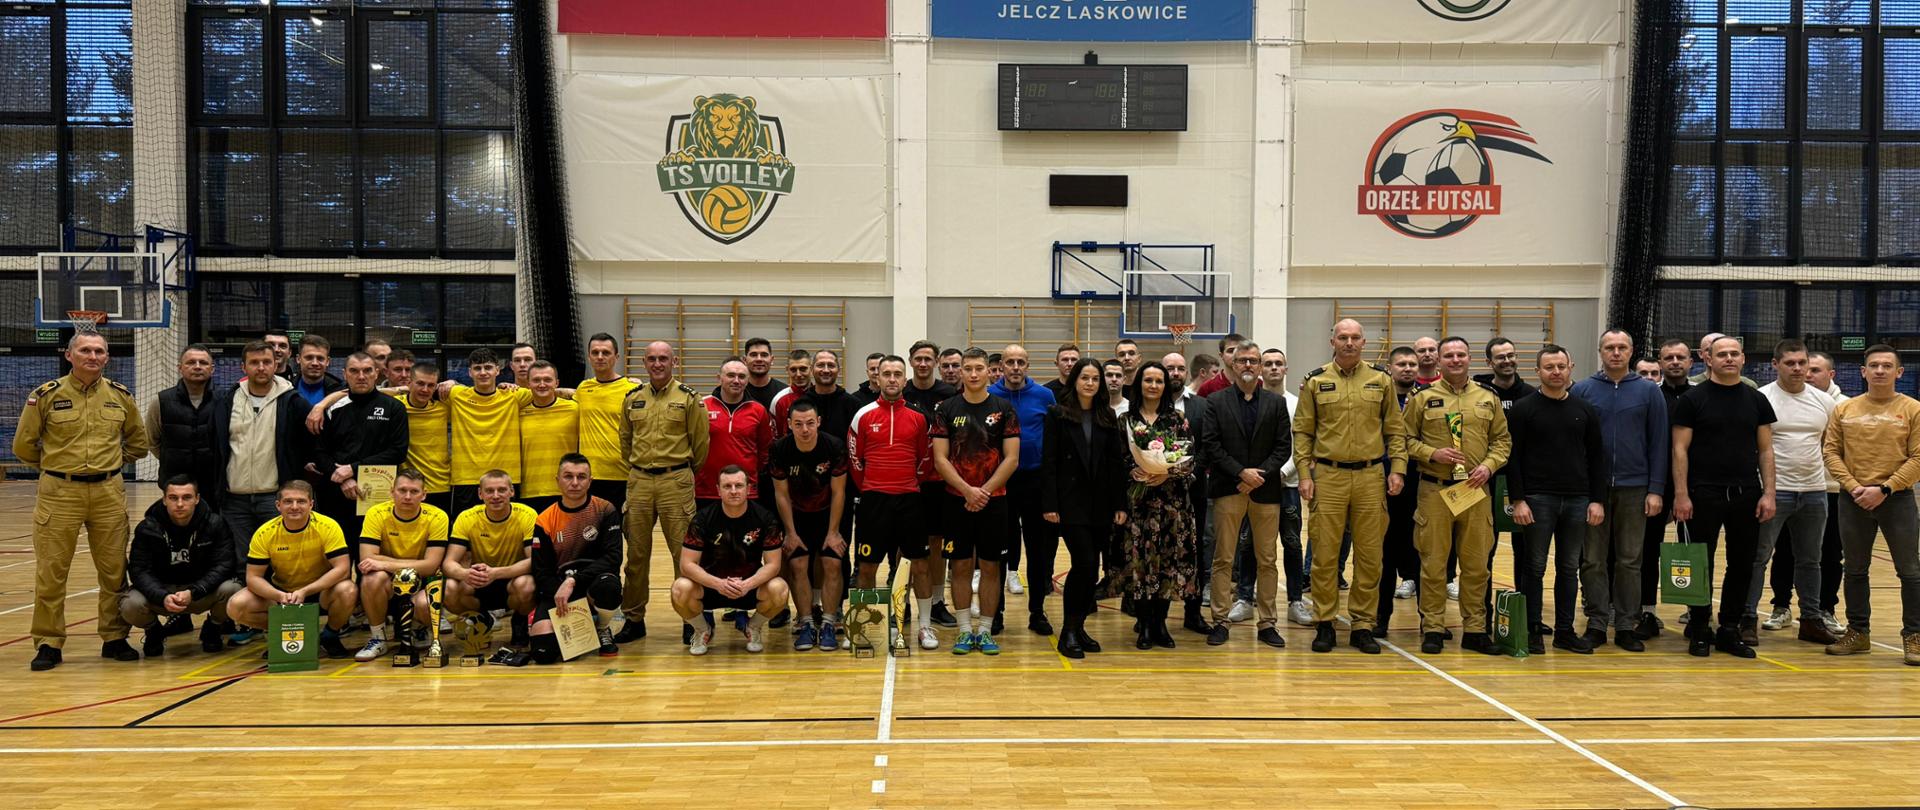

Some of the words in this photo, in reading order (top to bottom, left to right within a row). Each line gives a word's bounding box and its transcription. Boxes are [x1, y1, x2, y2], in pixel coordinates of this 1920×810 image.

[998, 5, 1060, 19] JELCZ
[1067, 6, 1187, 20] LASKOWICE
[663, 165, 694, 187] TS
[700, 163, 789, 188] VOLLEY
[1365, 190, 1421, 210] ORZEŁ
[1427, 190, 1494, 210] FUTSAL
[374, 407, 384, 415] 23
[953, 416, 966, 427] 44
[789, 465, 800, 476] 14
[714, 533, 723, 545] 2
[858, 543, 871, 557] 10
